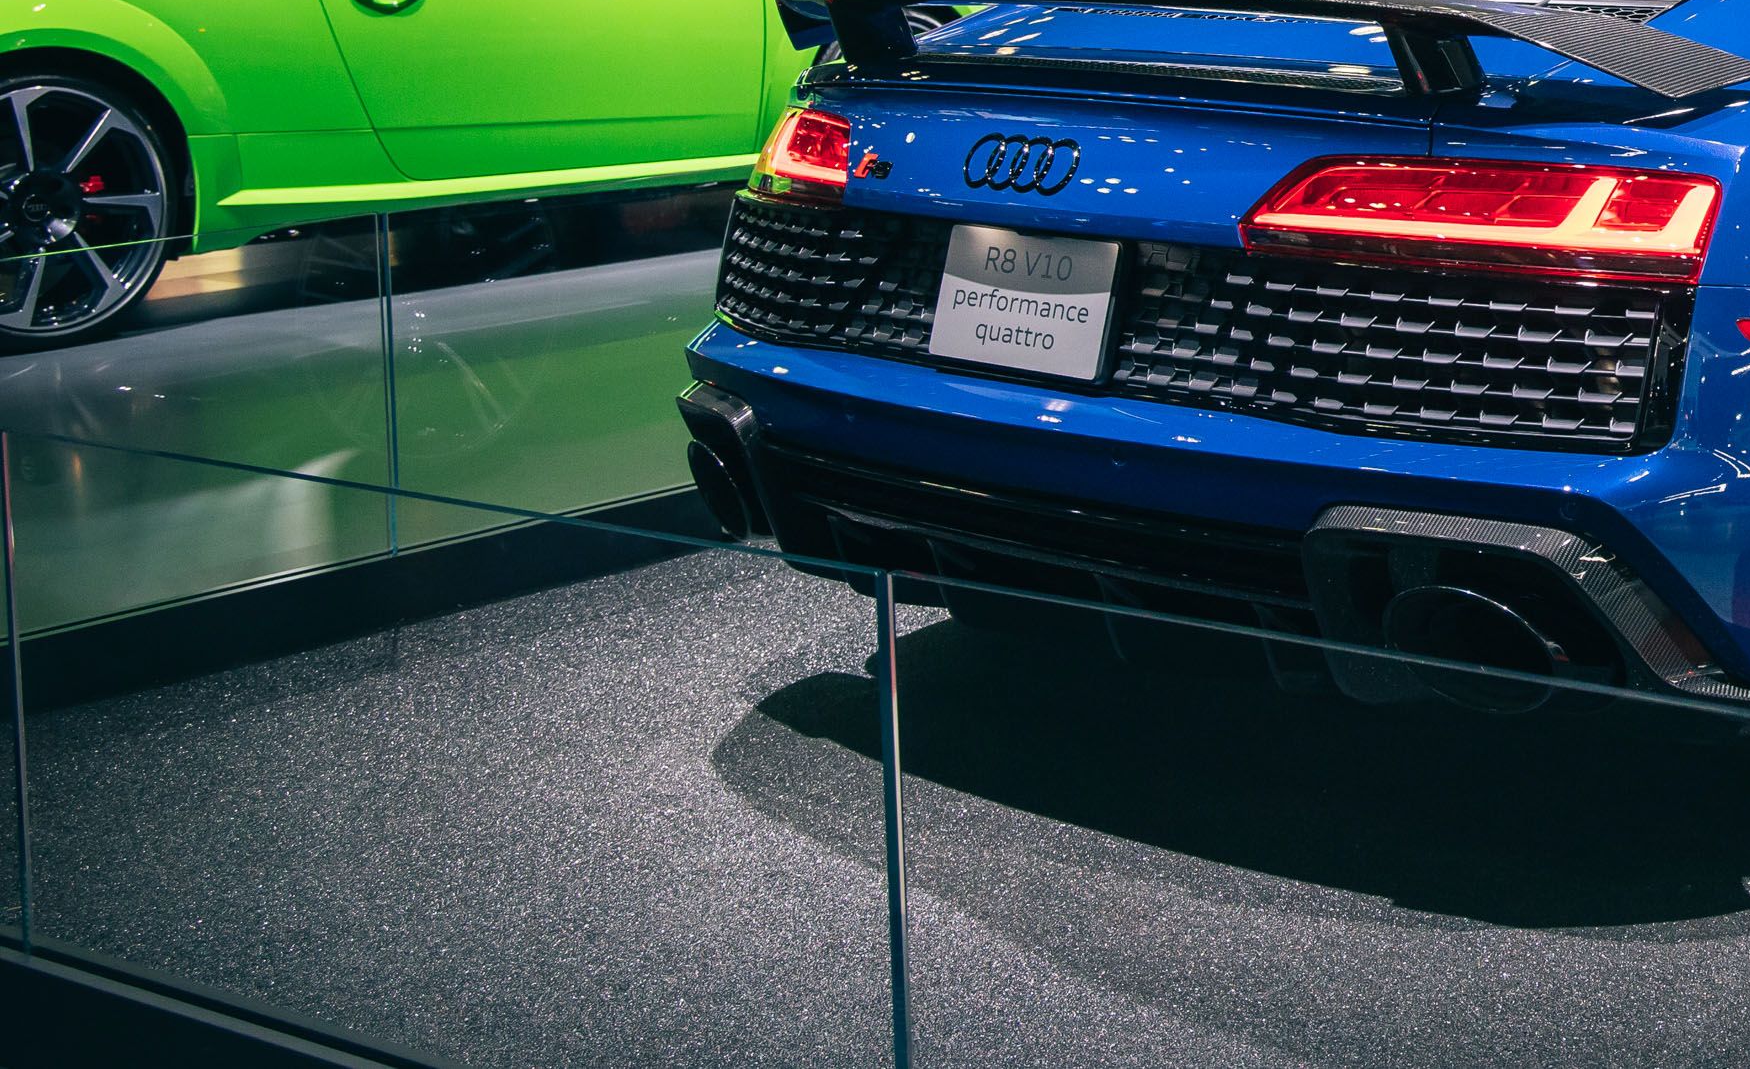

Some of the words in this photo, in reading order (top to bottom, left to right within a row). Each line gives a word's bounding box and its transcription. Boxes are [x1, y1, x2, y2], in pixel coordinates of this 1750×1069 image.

[985, 246, 1017, 274] R8
[1025, 251, 1073, 281] V10
[953, 288, 1089, 324] performance
[975, 322, 1055, 351] quattro
